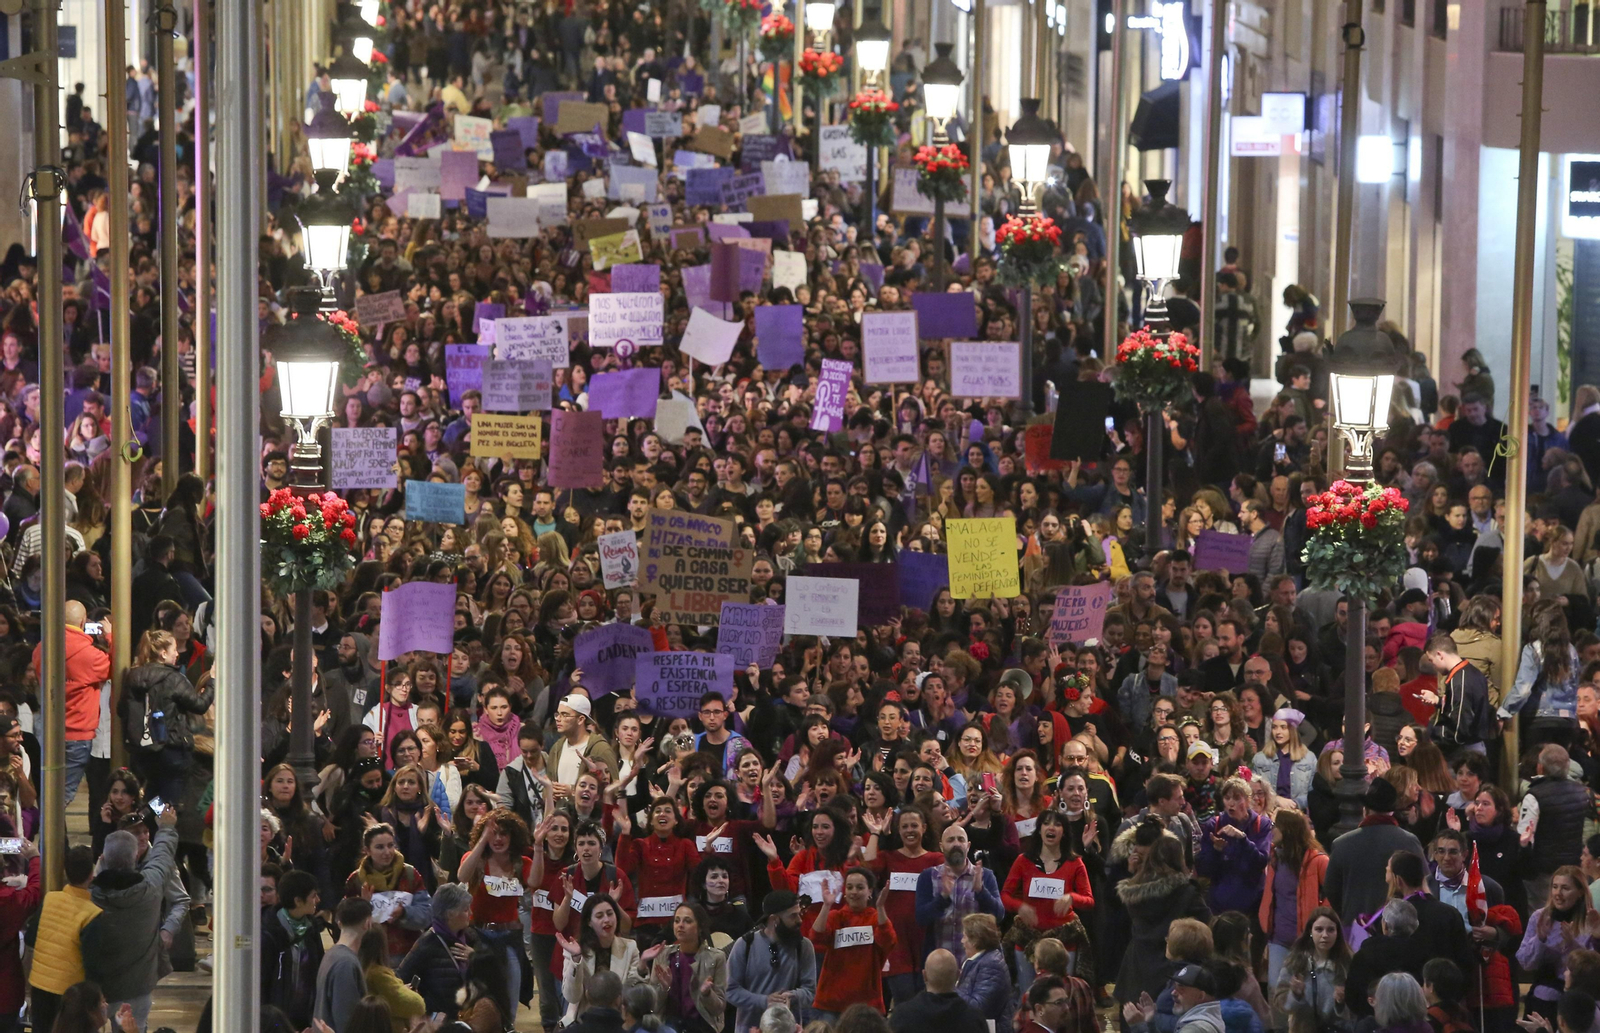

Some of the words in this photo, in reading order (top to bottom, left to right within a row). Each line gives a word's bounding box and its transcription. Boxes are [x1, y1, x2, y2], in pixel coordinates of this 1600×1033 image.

[652, 209, 669, 217] NO
[655, 224, 670, 233] NO
[457, 345, 470, 353] EL
[490, 372, 517, 380] TIENE
[535, 382, 549, 391] NO
[488, 393, 514, 403] TIENE
[833, 394, 841, 404] TE
[352, 428, 389, 440] EVERYONE
[506, 440, 536, 448] BICICLETA
[354, 477, 387, 485] ANOTHER
[651, 514, 666, 526] YO
[669, 517, 685, 529] OS
[651, 530, 693, 546] HIJAS
[964, 538, 980, 549] NO
[985, 535, 998, 547] SE
[603, 542, 636, 560] Reinas
[663, 545, 681, 558] DE
[675, 559, 686, 574] A
[690, 560, 729, 576] CASA
[952, 568, 1009, 582] FEMINISTAS
[659, 574, 715, 596] QUIERO
[717, 577, 749, 595] SER
[796, 581, 809, 591] Lo
[955, 585, 967, 595] LA
[1056, 596, 1086, 608] TIERRA
[1070, 607, 1084, 617] LAS
[675, 613, 720, 628] VALIEN
[1052, 617, 1089, 631] MUJERES
[720, 629, 743, 642] HOY
[744, 630, 762, 645] NO
[653, 654, 698, 666] RESPETA
[703, 656, 715, 667] MI
[660, 667, 717, 681] EXISTENCIA
[652, 680, 659, 693] O
[667, 680, 709, 693] ESPERA
[656, 695, 700, 711] RESISTE
[1034, 880, 1063, 896] JUNTAS
[640, 903, 655, 912] SIN
[837, 931, 871, 943] JUNTAS
